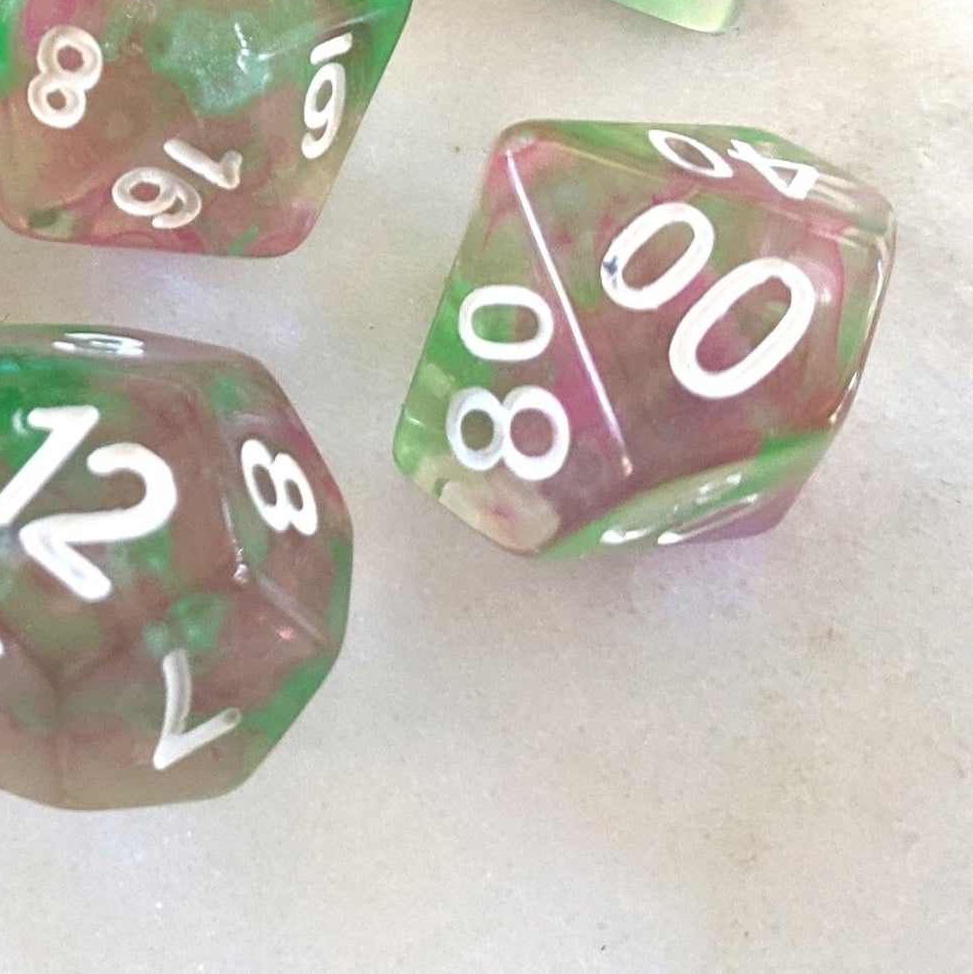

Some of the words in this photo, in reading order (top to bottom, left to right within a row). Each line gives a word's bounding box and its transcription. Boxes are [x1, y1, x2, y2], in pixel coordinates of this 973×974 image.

[27, 26, 103, 129] 8
[647, 129, 820, 201] 40
[600, 202, 816, 399] 00
[446, 283, 571, 482] 80
[240, 439, 318, 536] 8
[153, 648, 242, 771] 7
